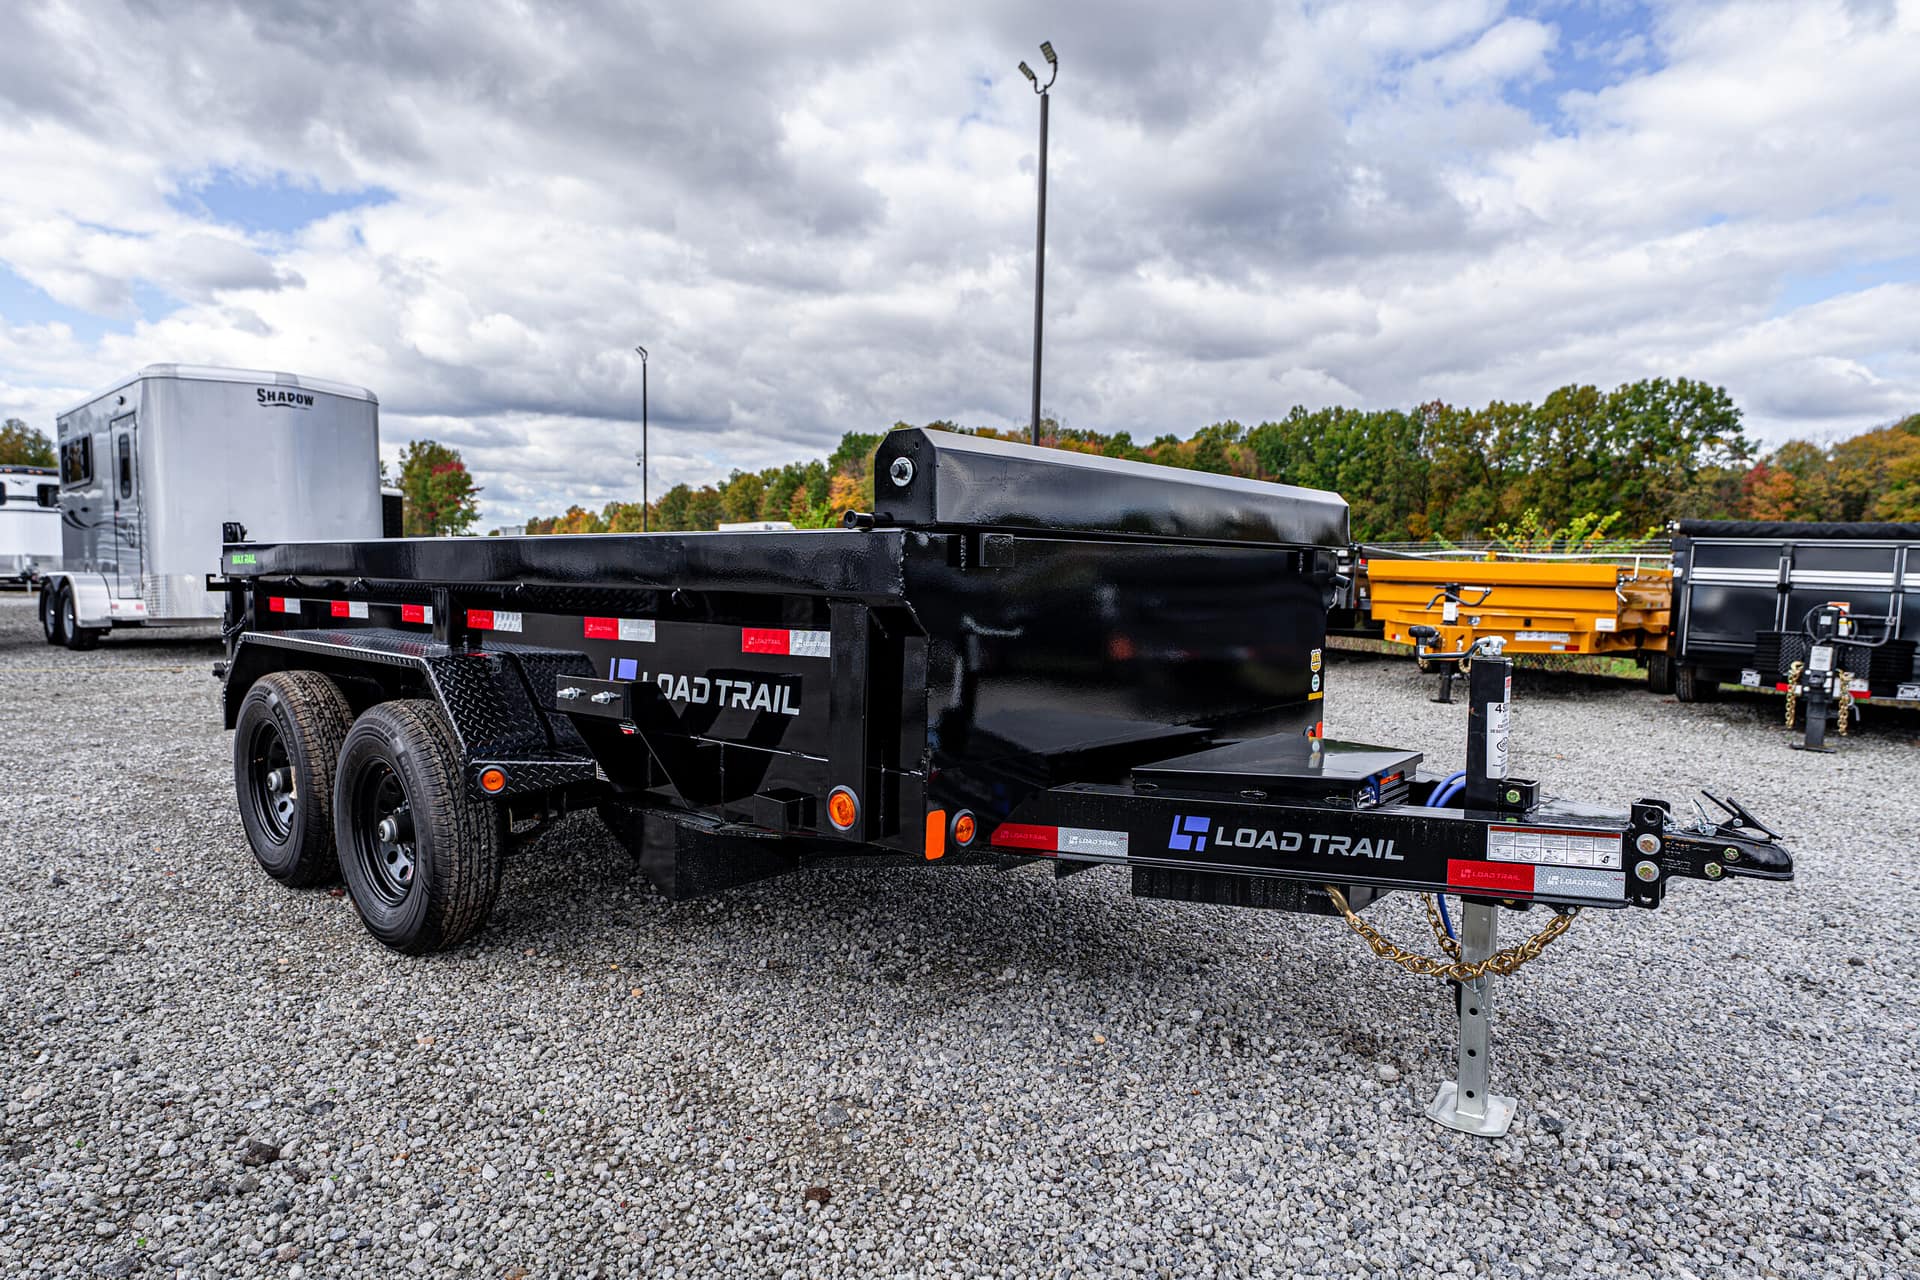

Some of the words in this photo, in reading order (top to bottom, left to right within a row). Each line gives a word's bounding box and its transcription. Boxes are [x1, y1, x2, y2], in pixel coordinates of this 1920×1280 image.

[257, 388, 314, 406] SHADOW
[715, 679, 800, 716] TRAIL
[1214, 826, 1303, 852] LOAD
[1309, 833, 1405, 861] TRAIL
